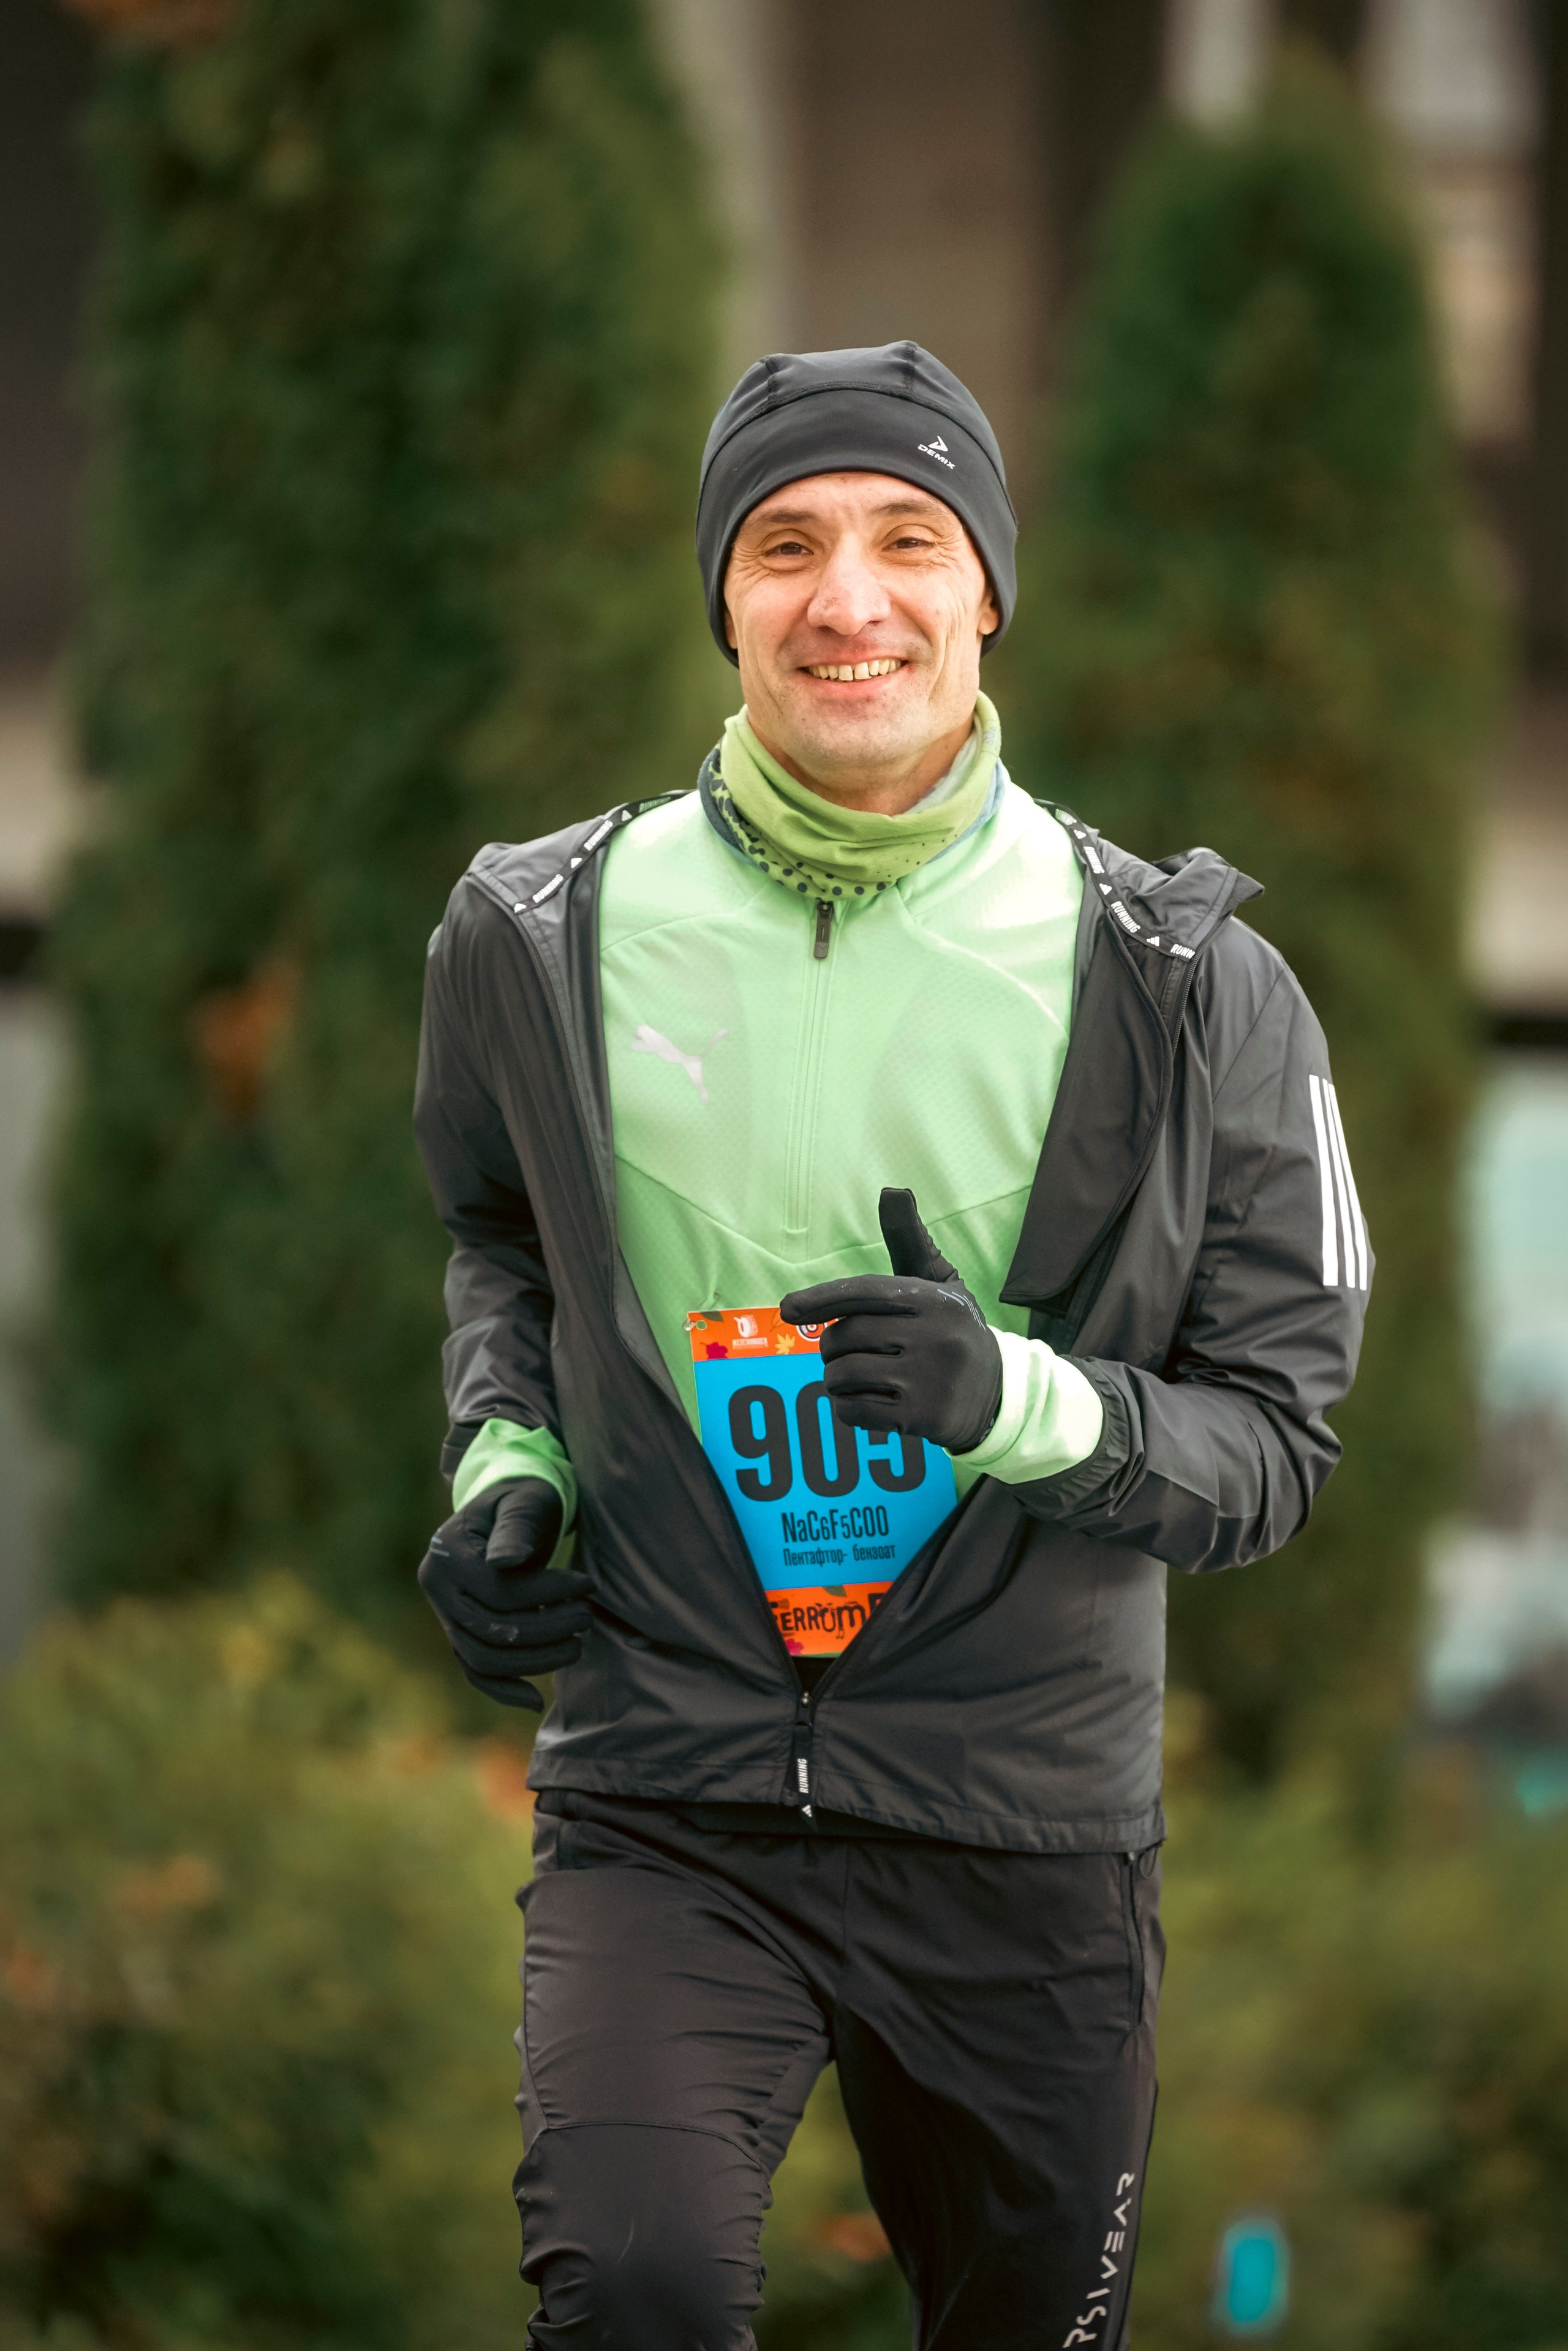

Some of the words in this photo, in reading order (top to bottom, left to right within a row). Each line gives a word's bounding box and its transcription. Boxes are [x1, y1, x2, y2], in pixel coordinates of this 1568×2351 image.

[918, 443, 956, 470] DEMIX
[1111, 900, 1140, 933] RUNNING
[1170, 943, 1196, 959] RUNN
[853, 1544, 895, 1561] бензоат
[797, 1758, 809, 1794] RUNNING
